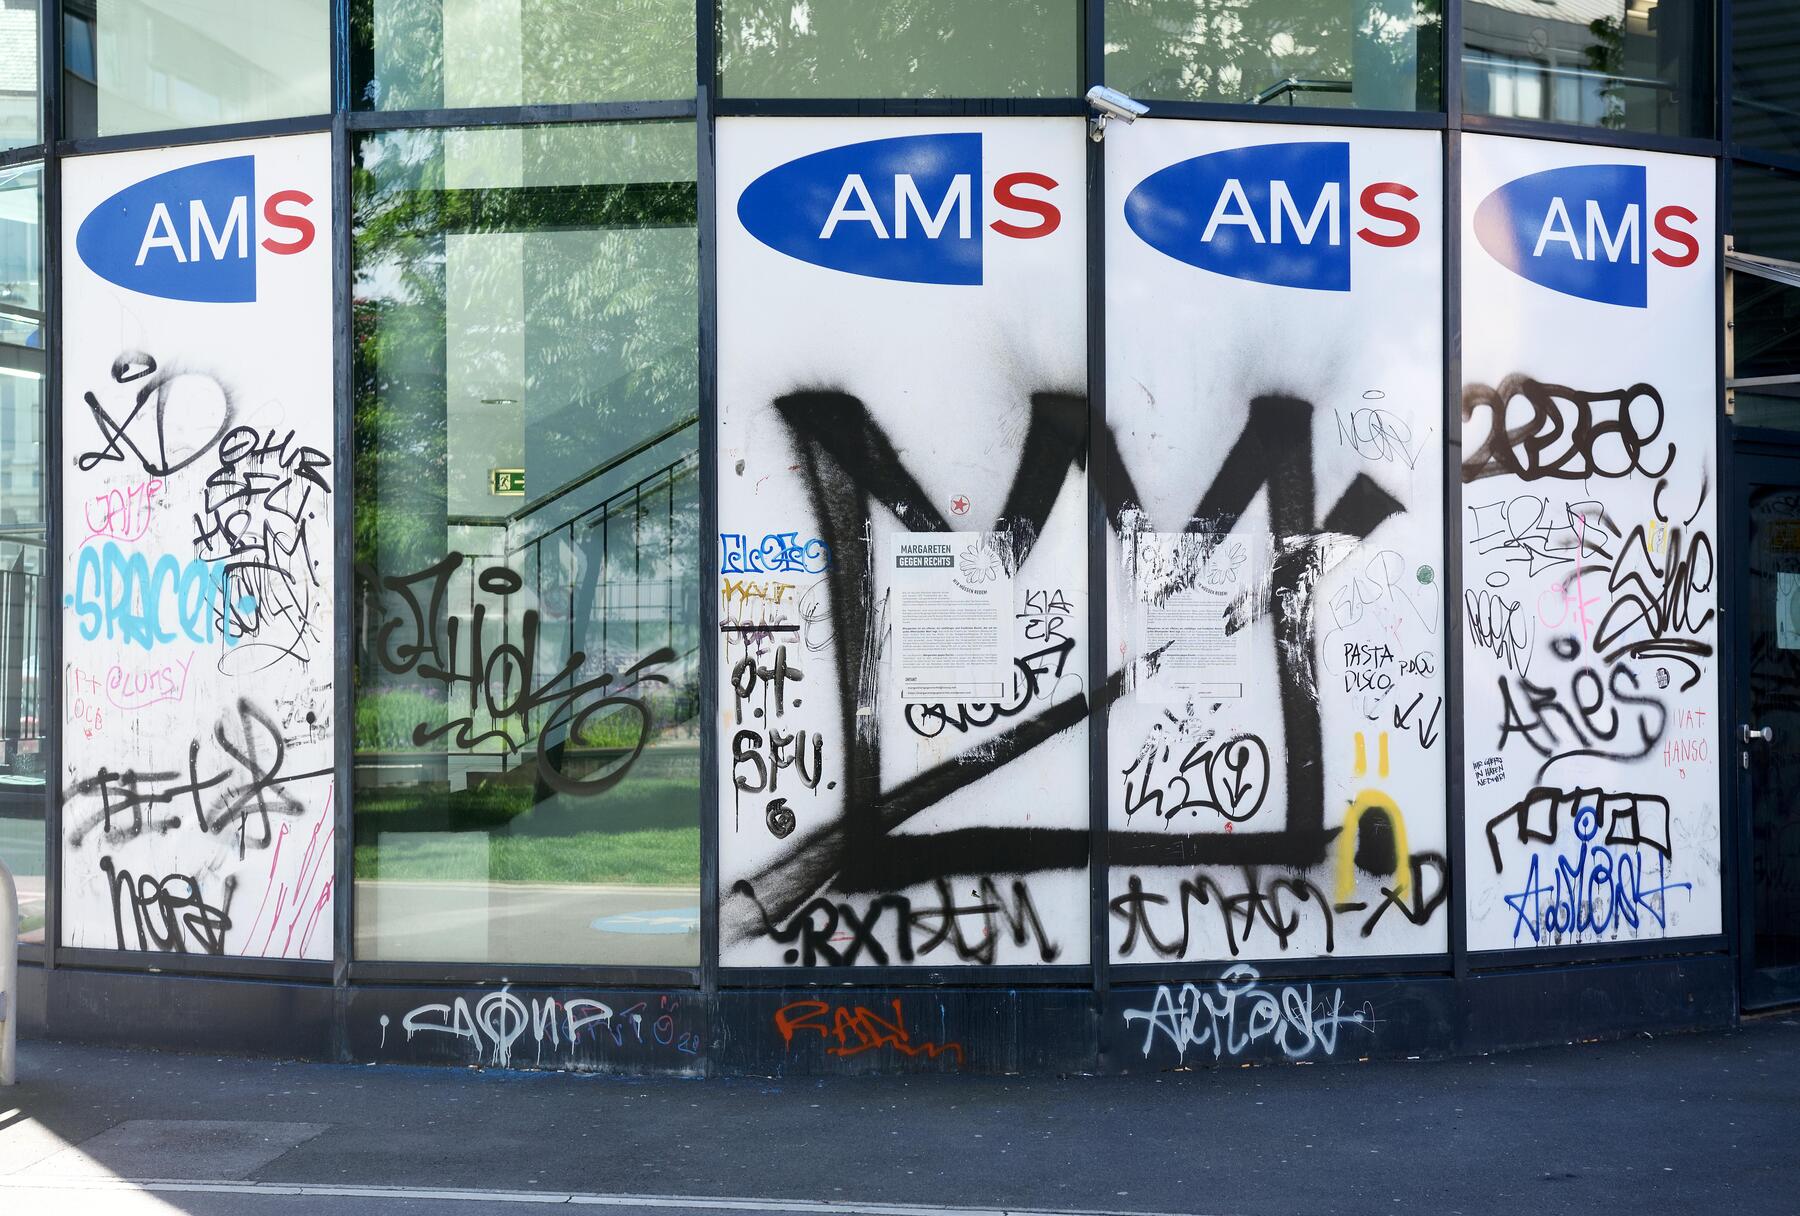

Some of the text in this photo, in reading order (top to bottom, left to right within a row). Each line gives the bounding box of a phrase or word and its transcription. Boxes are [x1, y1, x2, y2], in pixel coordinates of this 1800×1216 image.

[135, 190, 316, 266] AMS
[819, 172, 1062, 239] AMS
[1200, 179, 1421, 248] AMS
[1533, 197, 1700, 268] AMS
[900, 557, 951, 566] GEGEN RECHTS
[901, 545, 951, 554] MARGARETEN
[1344, 643, 1394, 669] PASTA
[1345, 669, 1391, 692] DISCO
